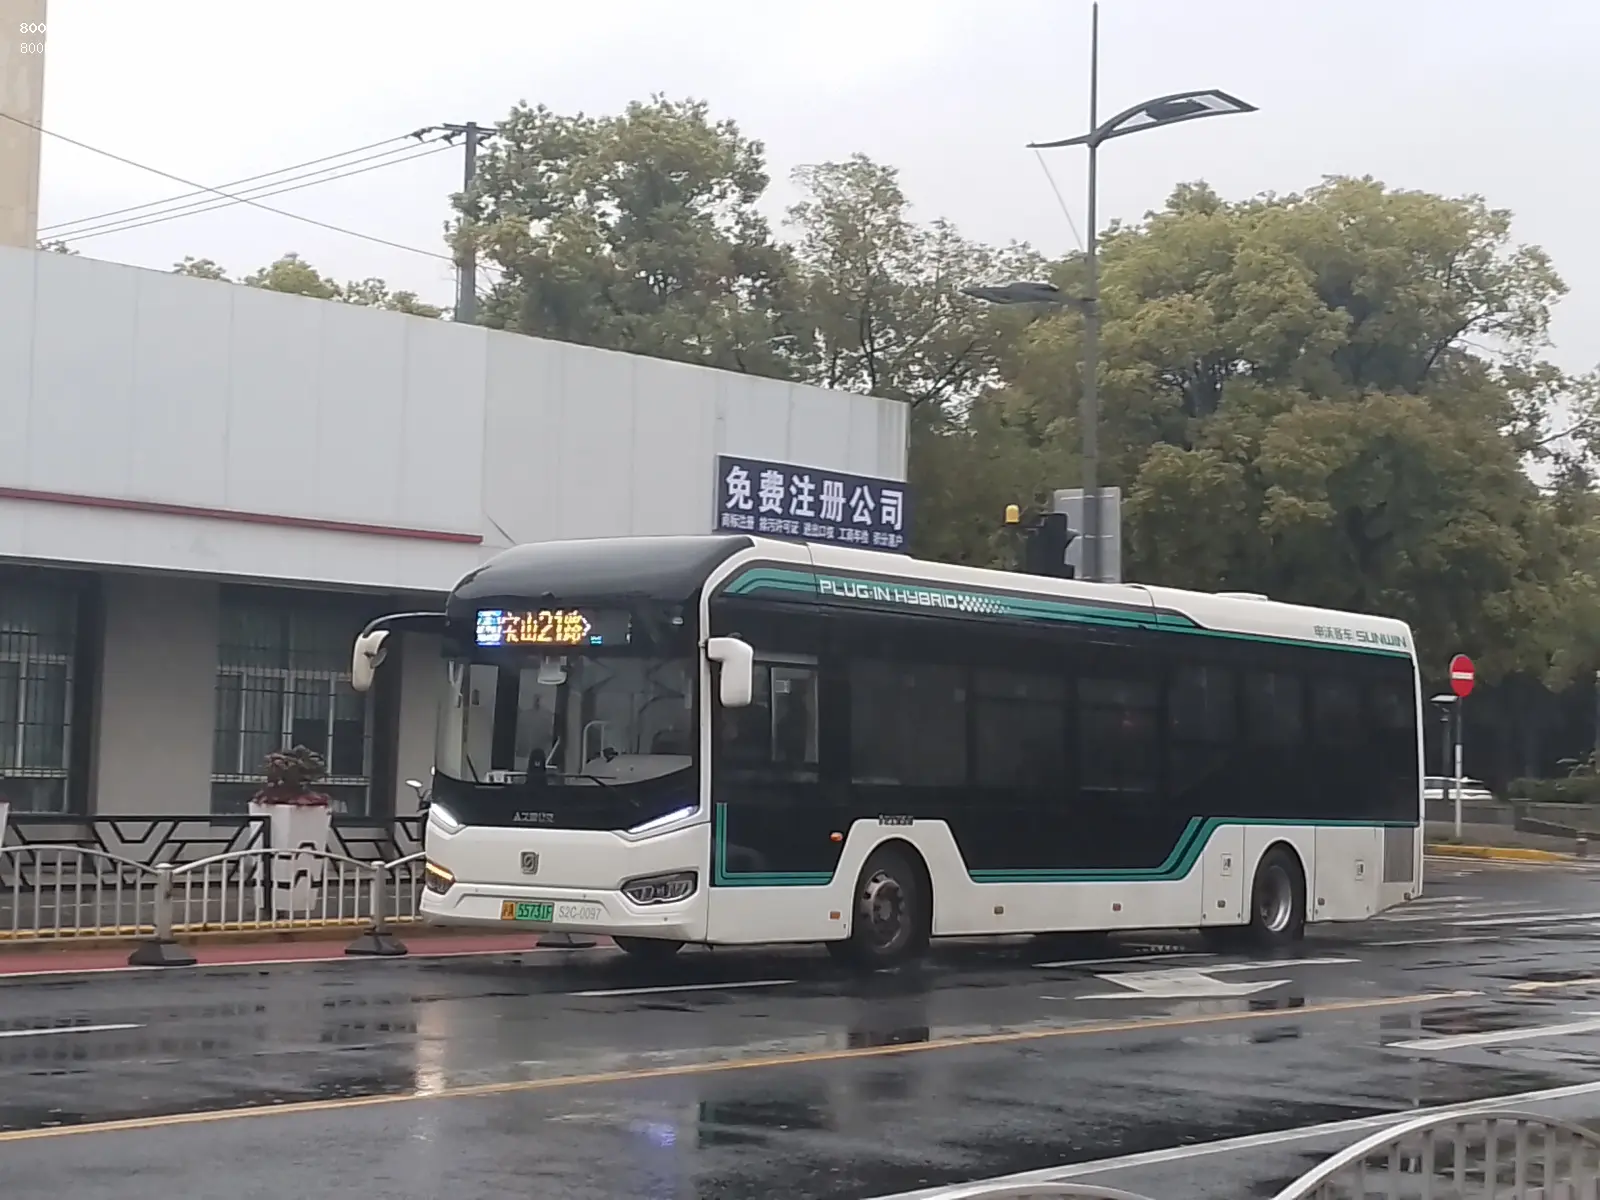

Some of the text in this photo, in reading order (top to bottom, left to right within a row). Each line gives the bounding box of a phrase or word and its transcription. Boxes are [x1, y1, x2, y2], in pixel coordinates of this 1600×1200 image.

[725, 465, 904, 531] 免费注册公司
[819, 579, 959, 610] PLUG-IN HYBRID
[1313, 624, 1407, 648] 申沃客车 SUNWIN
[558, 905, 602, 921] S2C-0097
